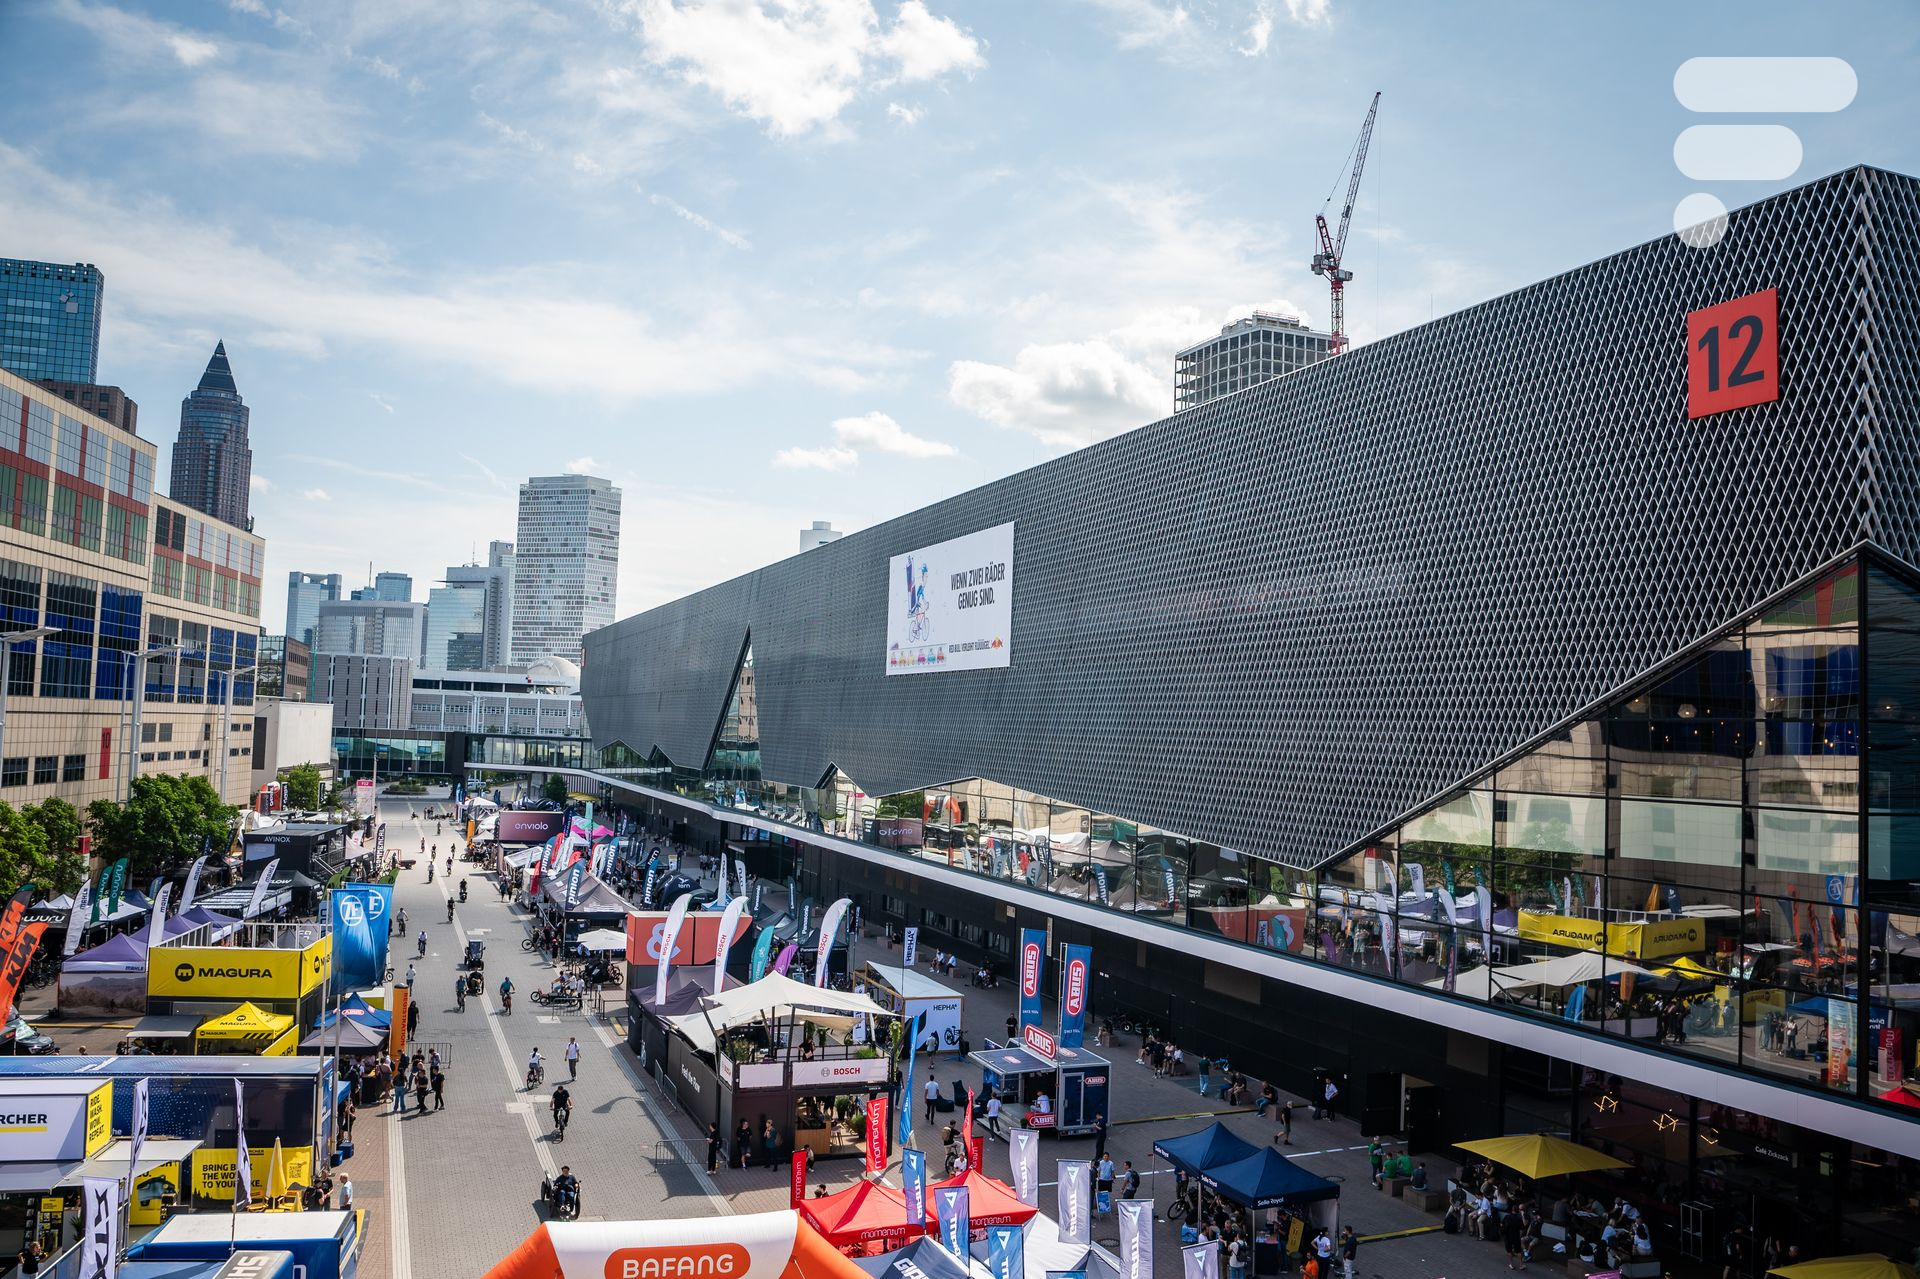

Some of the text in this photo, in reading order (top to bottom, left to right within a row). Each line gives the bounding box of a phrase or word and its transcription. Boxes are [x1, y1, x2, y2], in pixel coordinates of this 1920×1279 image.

[1698, 315, 1764, 392] 12
[951, 562, 1005, 590] WENN ZWEI RÄDER
[958, 587, 995, 610] GENUG SIND.
[102, 732, 111, 749] 10
[514, 821, 549, 830] onviolo
[540, 843, 552, 873] pinion
[606, 845, 616, 874] pinion
[112, 865, 123, 899] owuru
[193, 861, 203, 881] MAHLE
[265, 864, 275, 883] MAHLE
[80, 887, 89, 910] MAHLE
[568, 869, 580, 905] pinion
[644, 869, 655, 905] pinion
[160, 889, 169, 913] MAHLE
[344, 902, 362, 919] ZF
[21, 915, 66, 923] wuru
[662, 933, 671, 956] BOSCH
[717, 934, 727, 957] BOSCH
[819, 933, 828, 956] BOSCH
[6, 931, 38, 988] KTM
[1026, 950, 1037, 991] ABUS
[199, 968, 272, 978] MAGURA
[1070, 967, 1082, 1009] ABUS
[400, 992, 408, 1047] REGISTRATION
[1027, 1030, 1052, 1053] ABUS
[834, 1067, 860, 1075] BOSCH
[0, 1114, 47, 1124] RCHER
[1755, 1145, 1789, 1162] Café Zickzack
[202, 1164, 229, 1172] BRING
[202, 1172, 219, 1180] THE
[1069, 1189, 1077, 1236] GIANT
[1257, 1199, 1270, 1207] Selle
[861, 1227, 905, 1239] momentum
[622, 1254, 733, 1279] BAFANG
